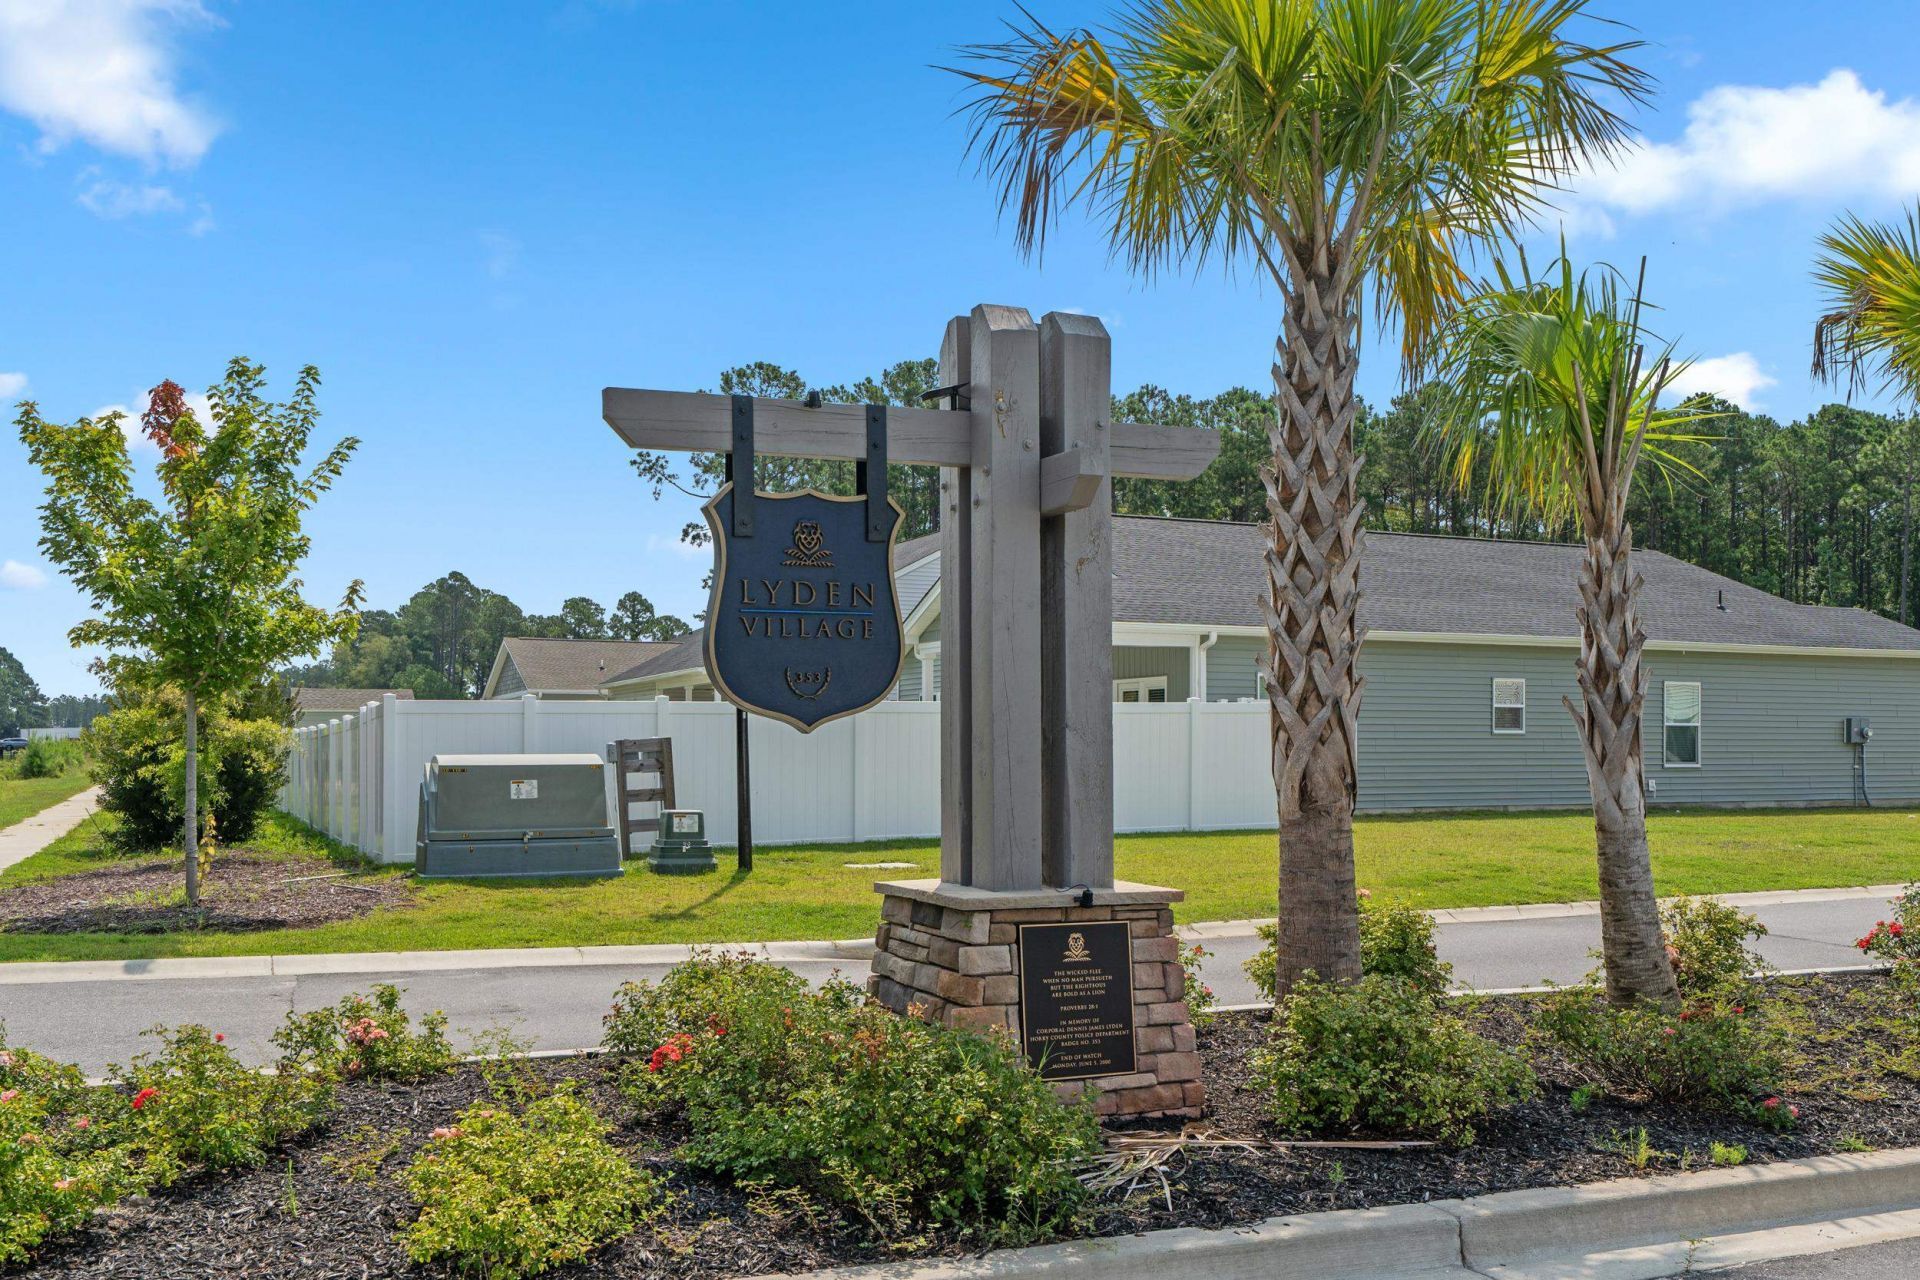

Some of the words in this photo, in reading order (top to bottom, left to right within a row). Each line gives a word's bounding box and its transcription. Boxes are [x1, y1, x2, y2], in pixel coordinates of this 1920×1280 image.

[741, 578, 876, 607] LYDEN
[740, 616, 874, 640] VILLAGE
[795, 671, 821, 684] 353
